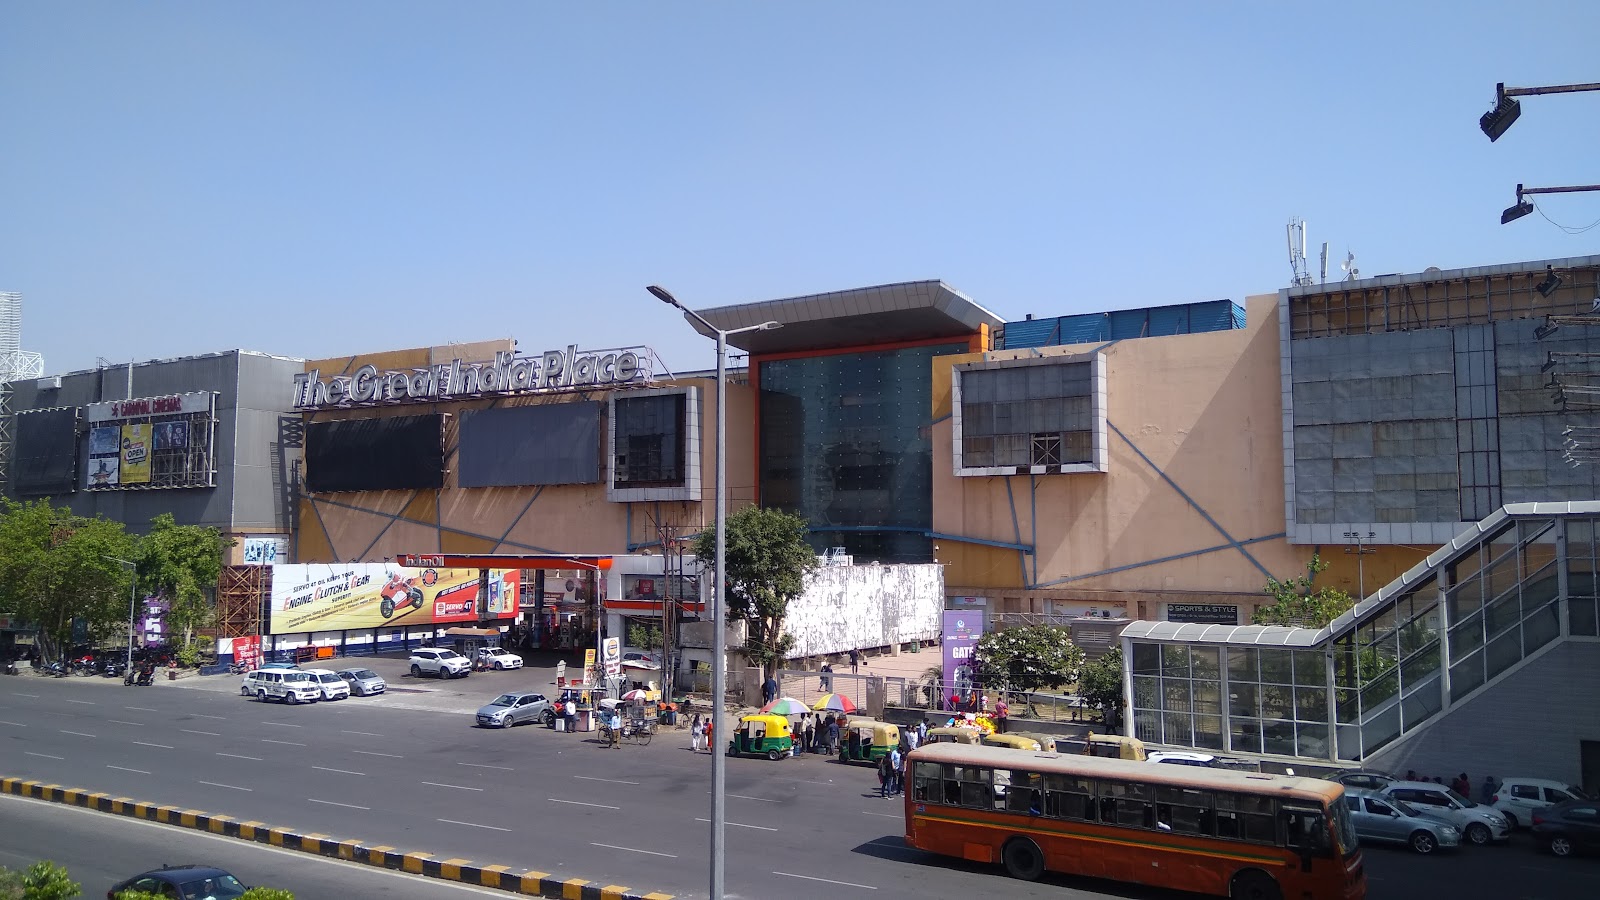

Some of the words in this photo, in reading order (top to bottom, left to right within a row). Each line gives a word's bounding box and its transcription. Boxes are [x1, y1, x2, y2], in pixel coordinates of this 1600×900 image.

[293, 369, 345, 408] The
[350, 364, 442, 401] Great
[446, 351, 534, 395] India
[538, 344, 639, 387] Place
[121, 400, 151, 416] CARNIVAL
[153, 398, 182, 412] CINEMAS
[128, 448, 144, 458] OPEN
[405, 555, 445, 567] IndianOil
[283, 594, 314, 611] ENGINE,
[314, 584, 343, 600] CLUTCH
[343, 581, 350, 592] &
[351, 575, 371, 589] GEAR
[294, 583, 309, 593] SERVO
[445, 603, 463, 611] SERVO
[463, 601, 473, 610] 4T
[145, 617, 161, 641] 5
